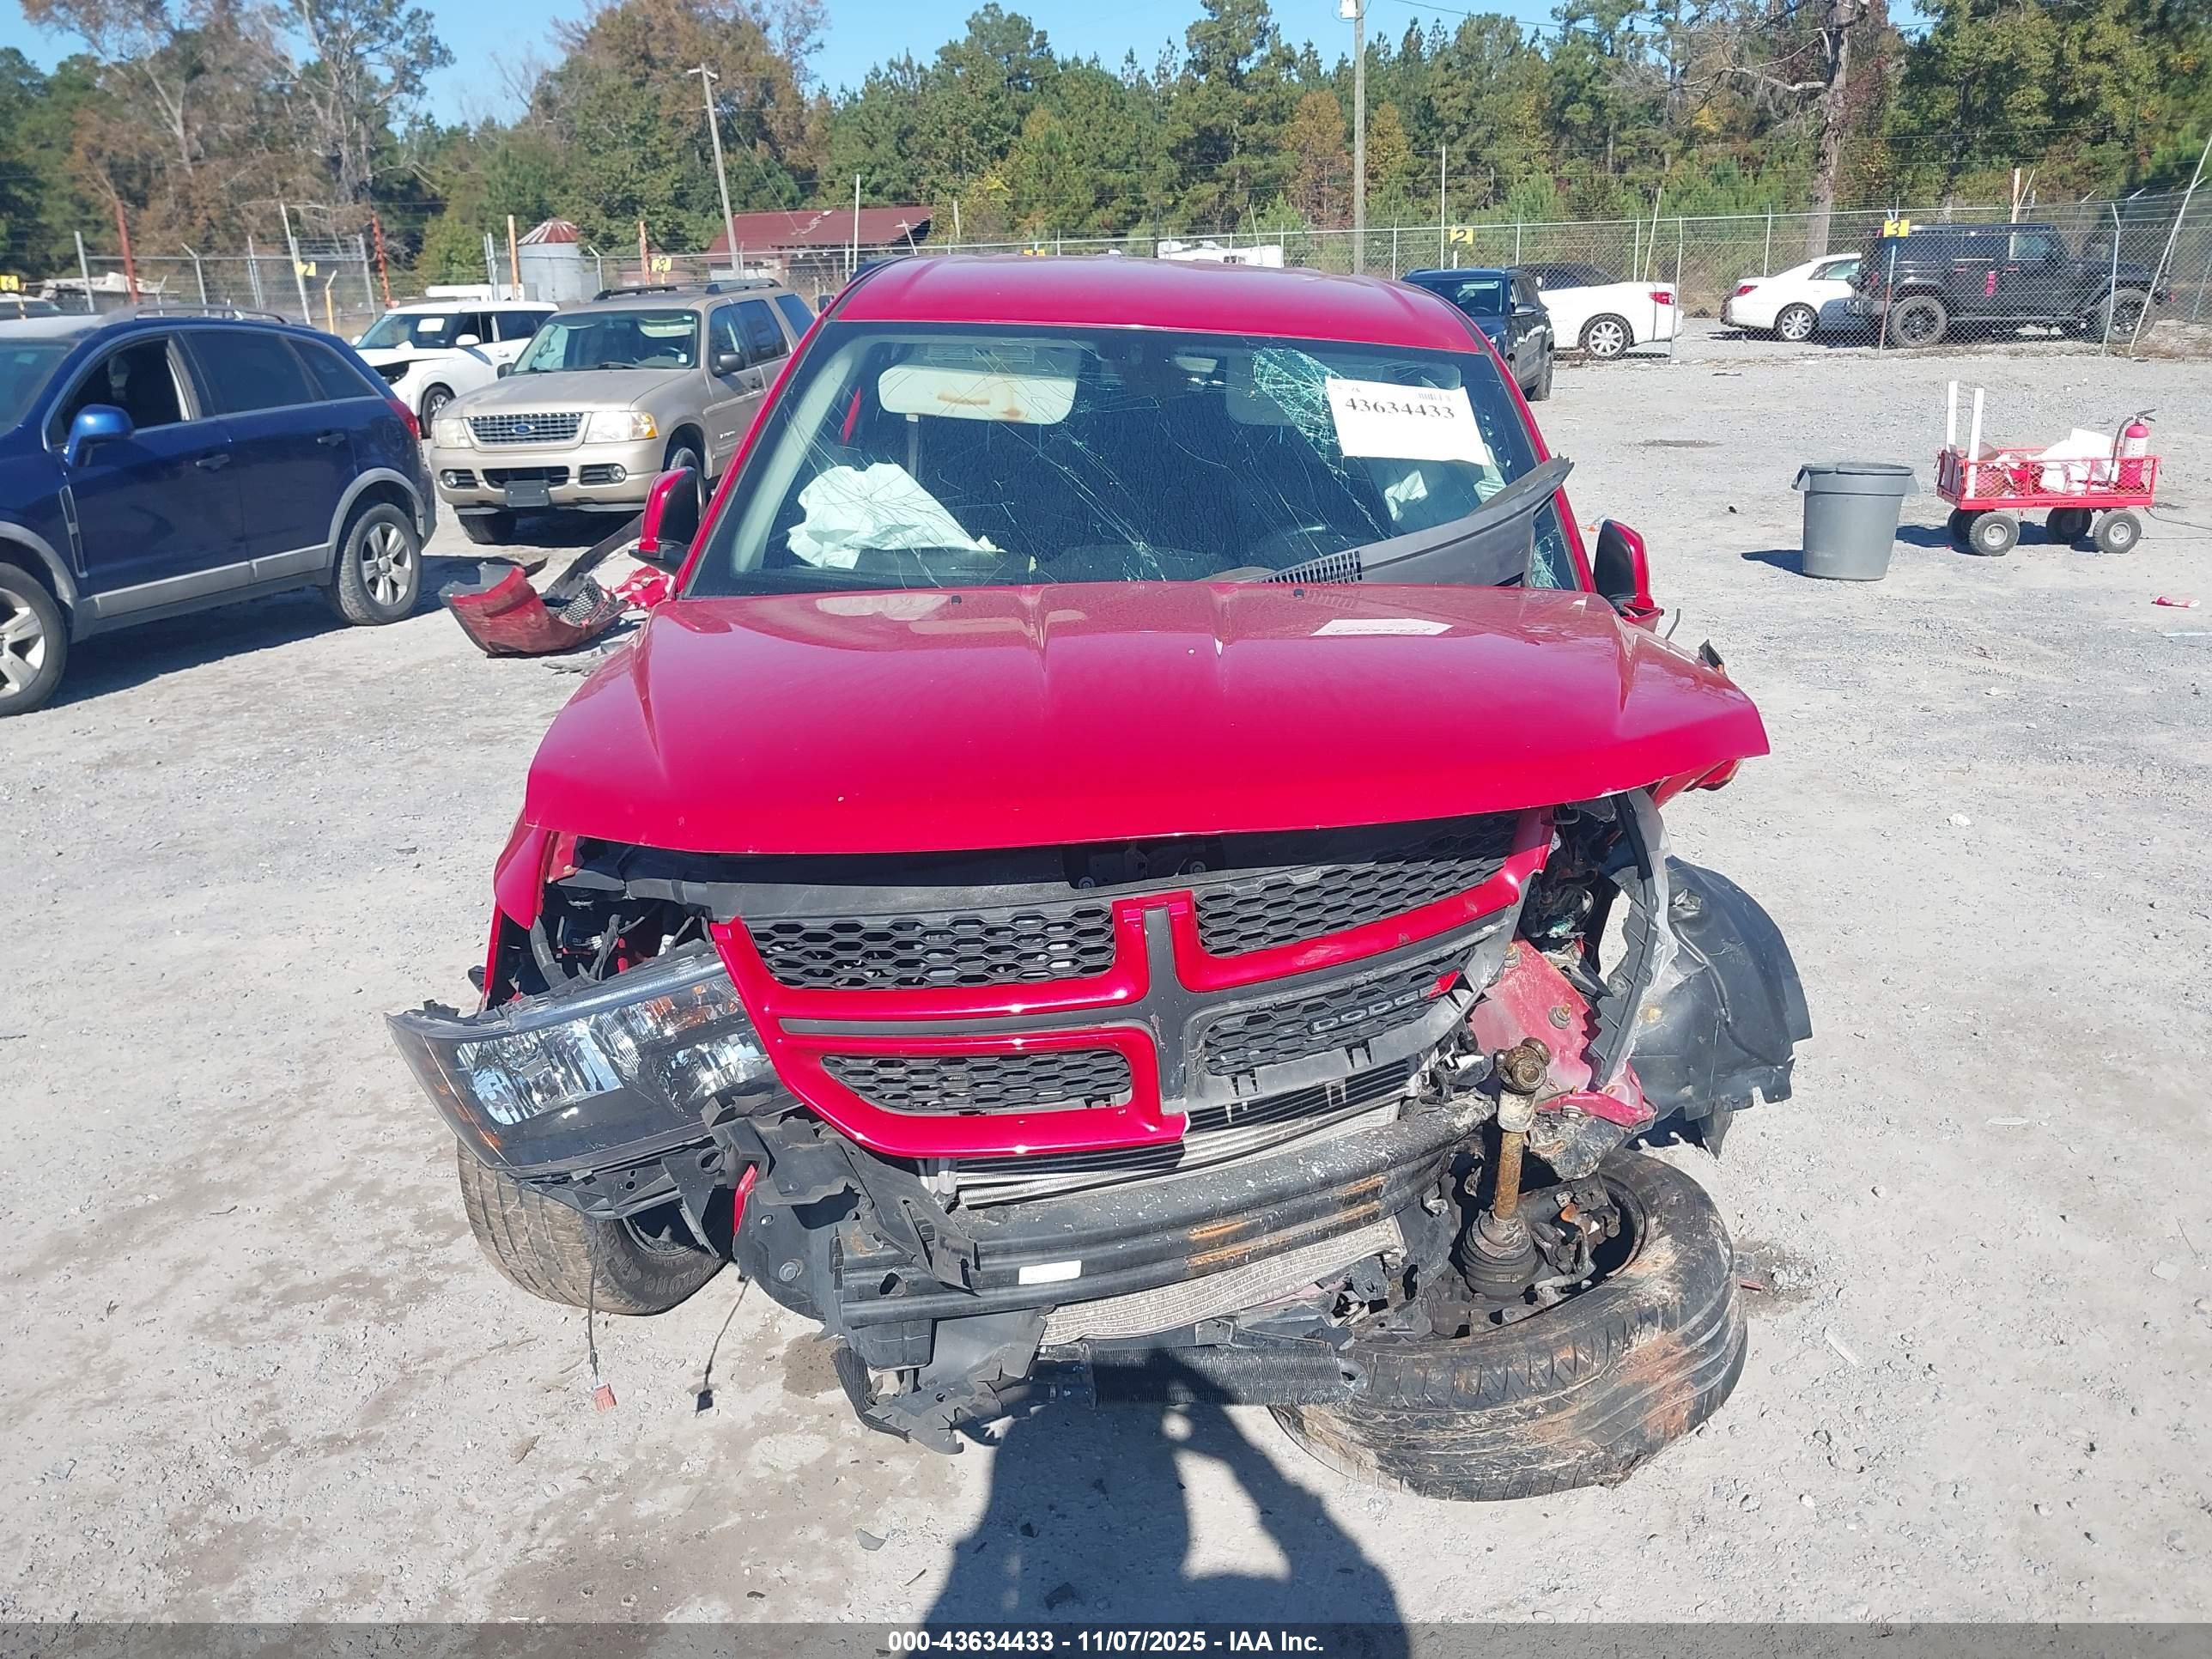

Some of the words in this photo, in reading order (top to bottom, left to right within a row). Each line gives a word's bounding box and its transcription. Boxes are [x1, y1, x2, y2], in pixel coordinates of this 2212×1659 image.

[1451, 228, 1468, 244] 2
[1890, 220, 1901, 237] 3
[1345, 397, 1455, 419] 43634433
